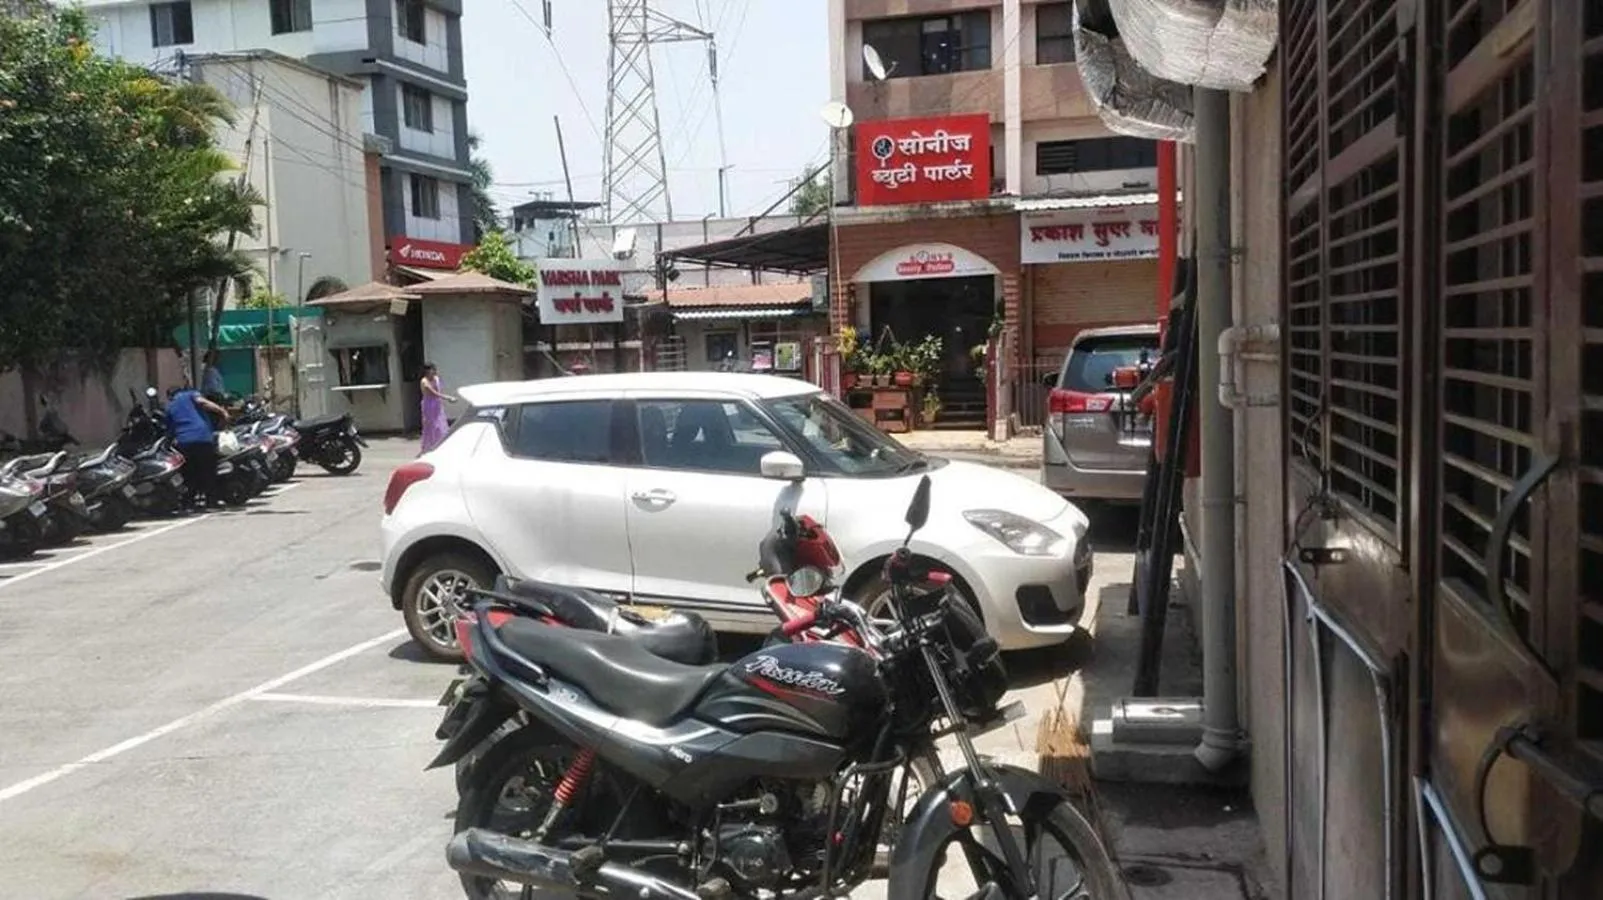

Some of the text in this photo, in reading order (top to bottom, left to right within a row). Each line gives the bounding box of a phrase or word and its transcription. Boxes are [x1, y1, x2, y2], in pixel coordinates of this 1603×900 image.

[898, 129, 972, 155] सोनीज
[923, 158, 973, 181] पार्लर
[1029, 223, 1085, 243] प्रकाश
[1092, 220, 1131, 247] सुपर
[411, 248, 446, 263] HONDA
[540, 269, 621, 286] VARSHA PARK
[552, 290, 614, 314] वर्षा पार्क
[745, 655, 846, 694] Passion
